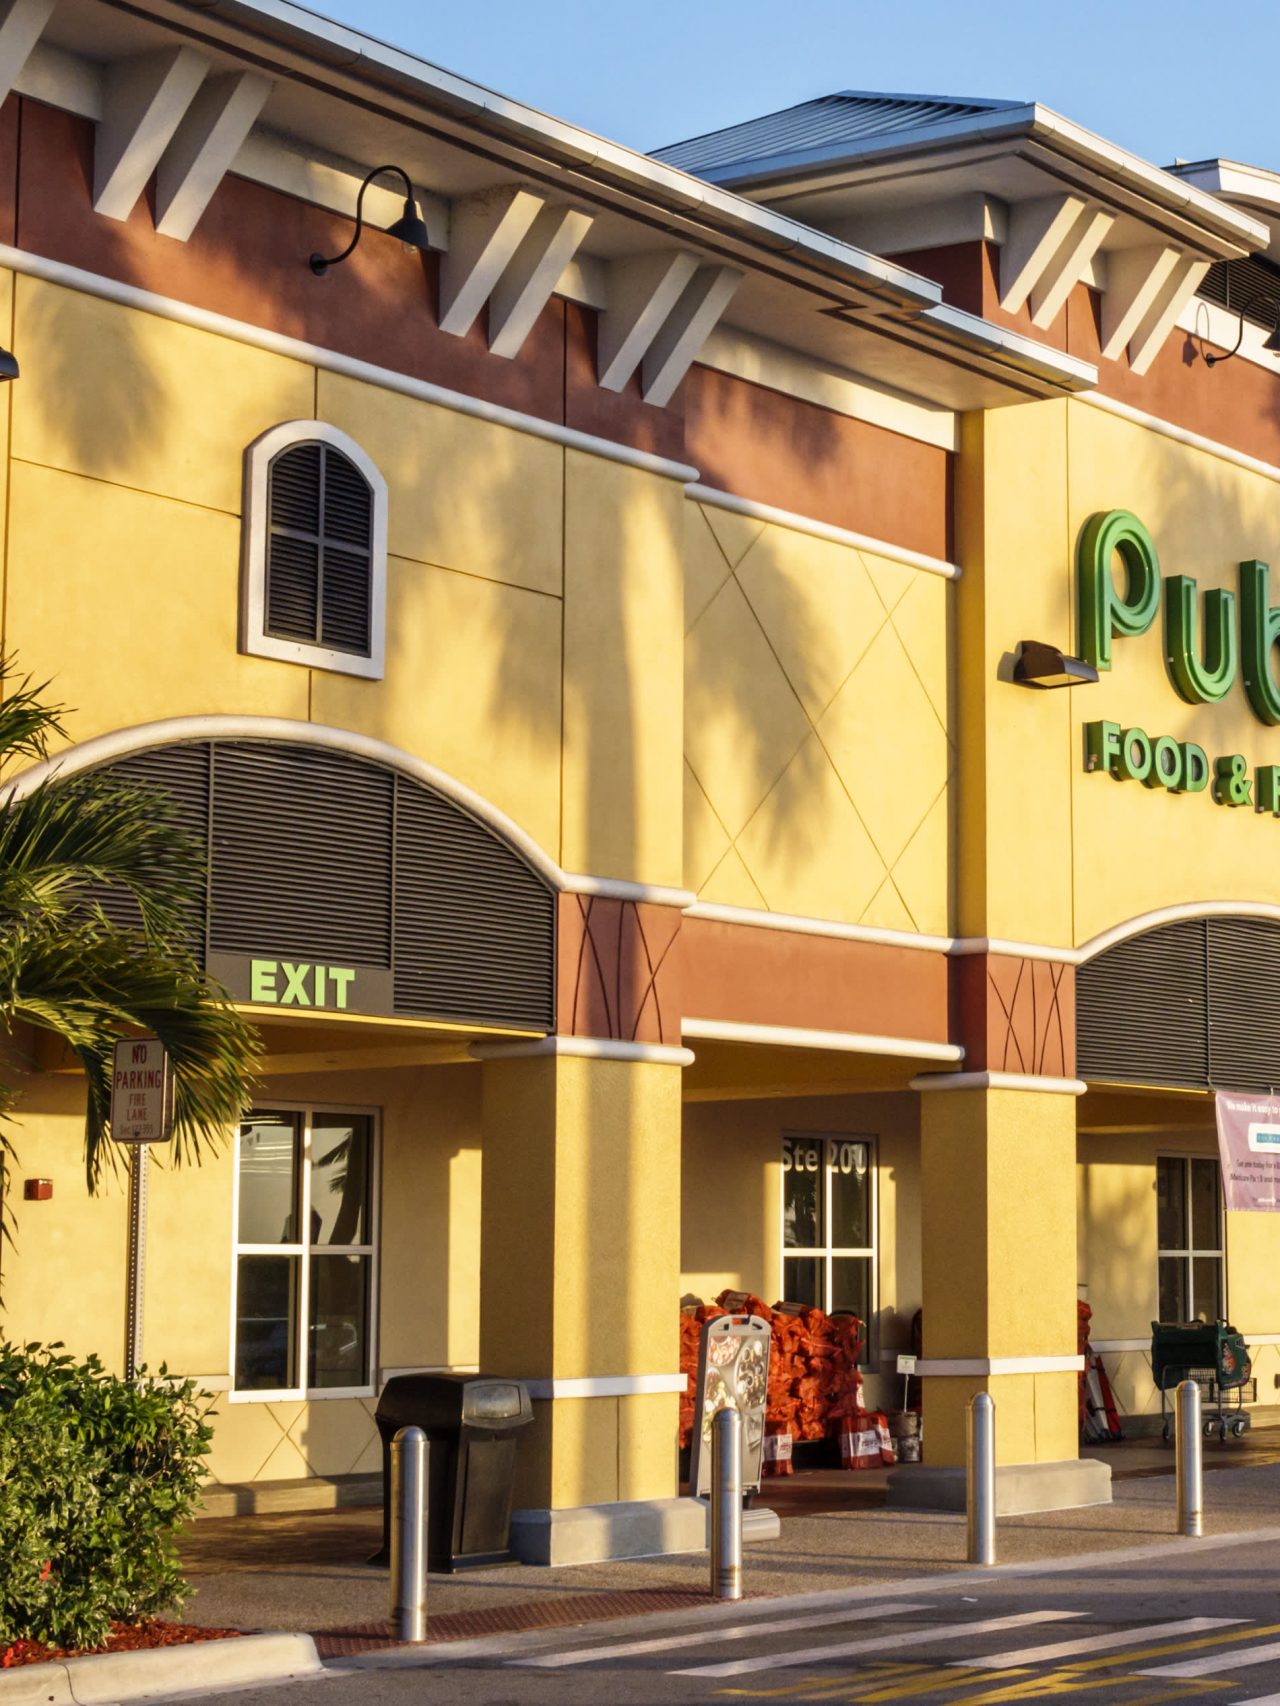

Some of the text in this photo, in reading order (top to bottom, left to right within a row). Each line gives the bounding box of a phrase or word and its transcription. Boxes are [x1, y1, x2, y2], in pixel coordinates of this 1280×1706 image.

[1083, 720, 1209, 793] FOOD
[1213, 754, 1253, 807] &
[250, 959, 355, 1009] EXIT
[132, 1044, 147, 1064] NO
[116, 1070, 162, 1089] PARKING
[129, 1093, 146, 1106] FIRE
[126, 1108, 147, 1121] LANE
[783, 1140, 818, 1172] Ste
